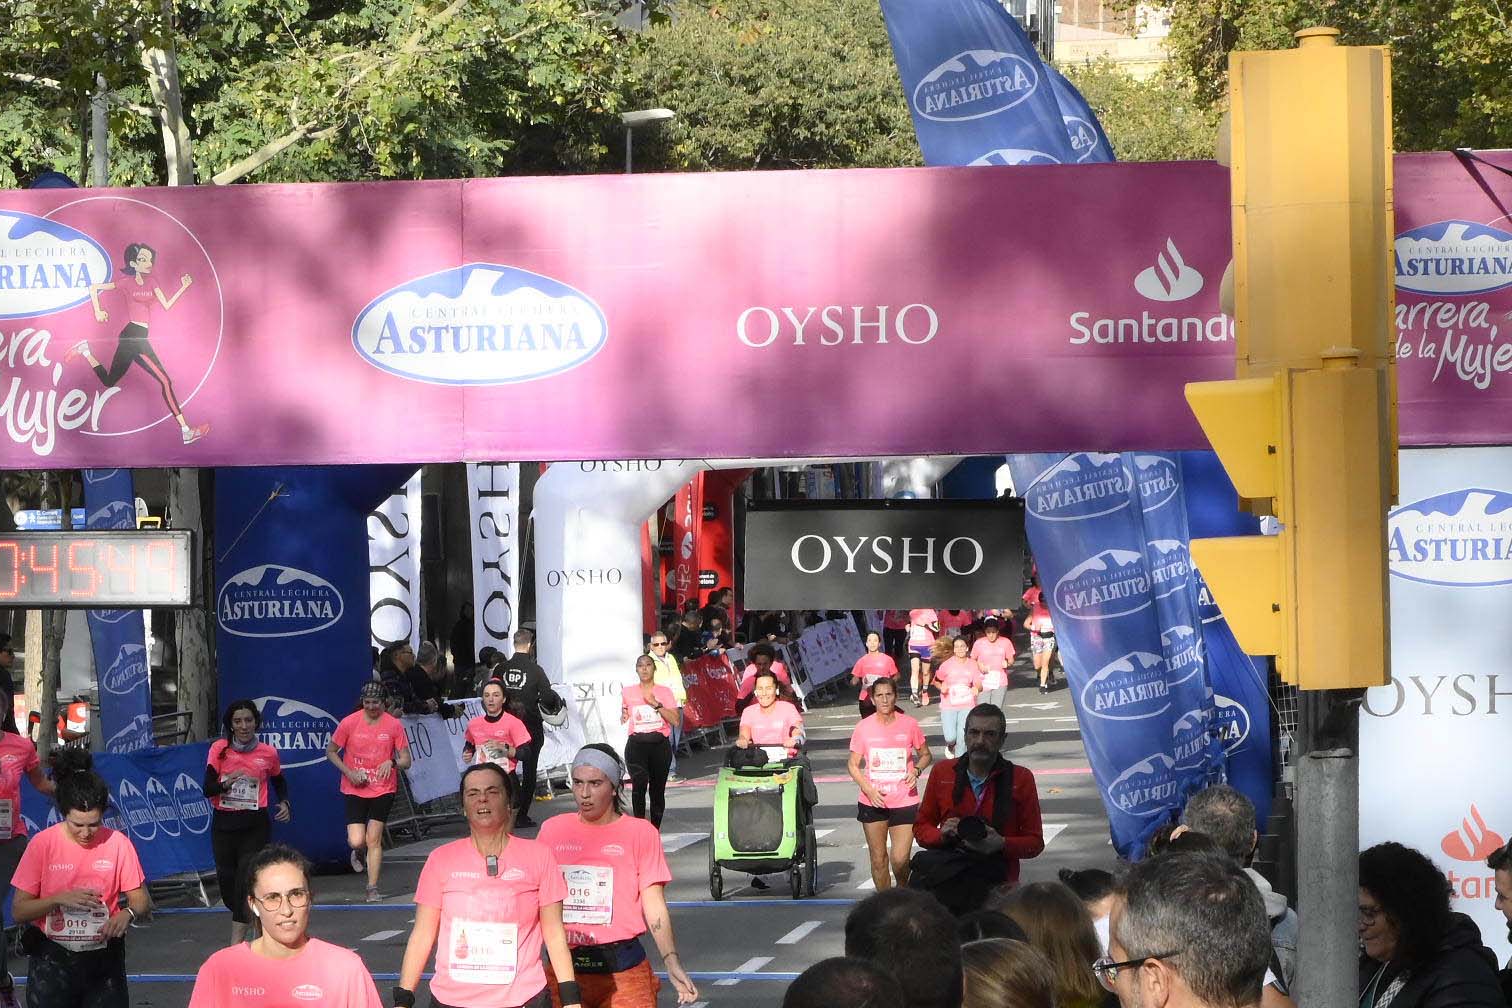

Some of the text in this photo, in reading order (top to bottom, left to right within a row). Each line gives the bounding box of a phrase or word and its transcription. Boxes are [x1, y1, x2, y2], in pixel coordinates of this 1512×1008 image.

[15, 247, 87, 257] LECHERA
[737, 303, 938, 348] OYSHO
[1069, 311, 1234, 343] Santand
[1395, 300, 1491, 331] arrera
[374, 310, 586, 356] ASTURIANA
[1419, 332, 1436, 358] la
[1432, 329, 1512, 390] Muje
[1416, 523, 1483, 533] CENTRAL
[790, 534, 984, 576] OYSHO
[1388, 526, 1512, 563] ASTURI
[547, 568, 622, 587] OYSHO
[222, 594, 334, 621] ASTURIANA
[1360, 674, 1512, 718] OYSH
[570, 888, 590, 897] 016
[67, 920, 88, 928] 016
